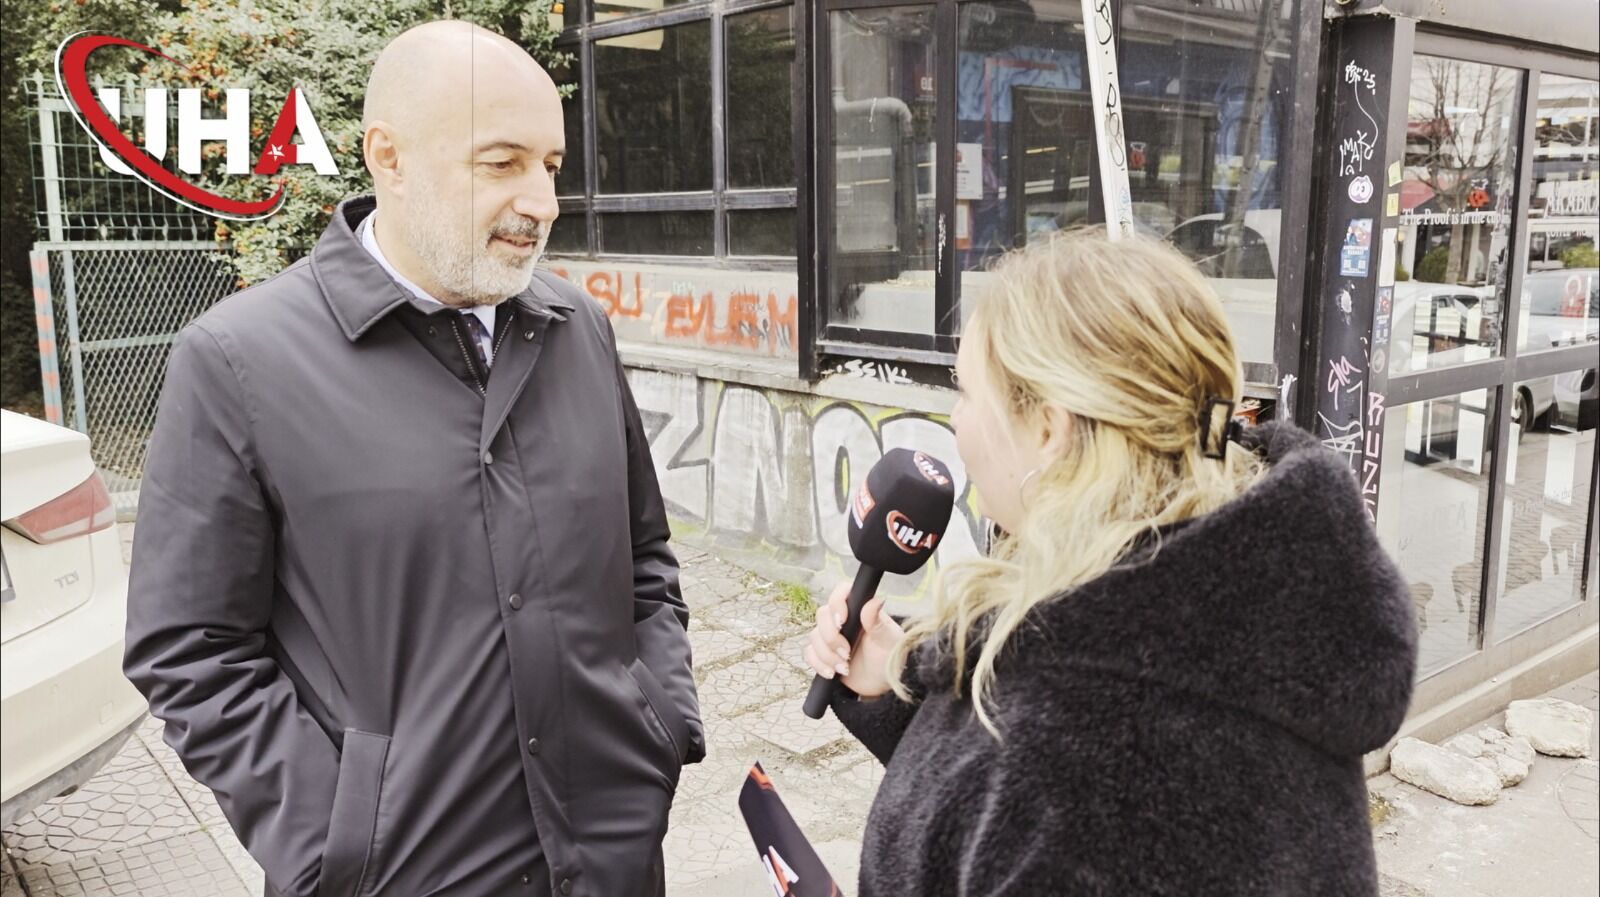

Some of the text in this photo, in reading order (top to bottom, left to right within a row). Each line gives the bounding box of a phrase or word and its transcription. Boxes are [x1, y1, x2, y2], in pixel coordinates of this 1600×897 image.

[1544, 188, 1598, 218] ARABIC
[1402, 207, 1421, 226] The
[1423, 207, 1451, 226] Proof
[1451, 208, 1460, 225] is
[53, 569, 80, 589] TDI
